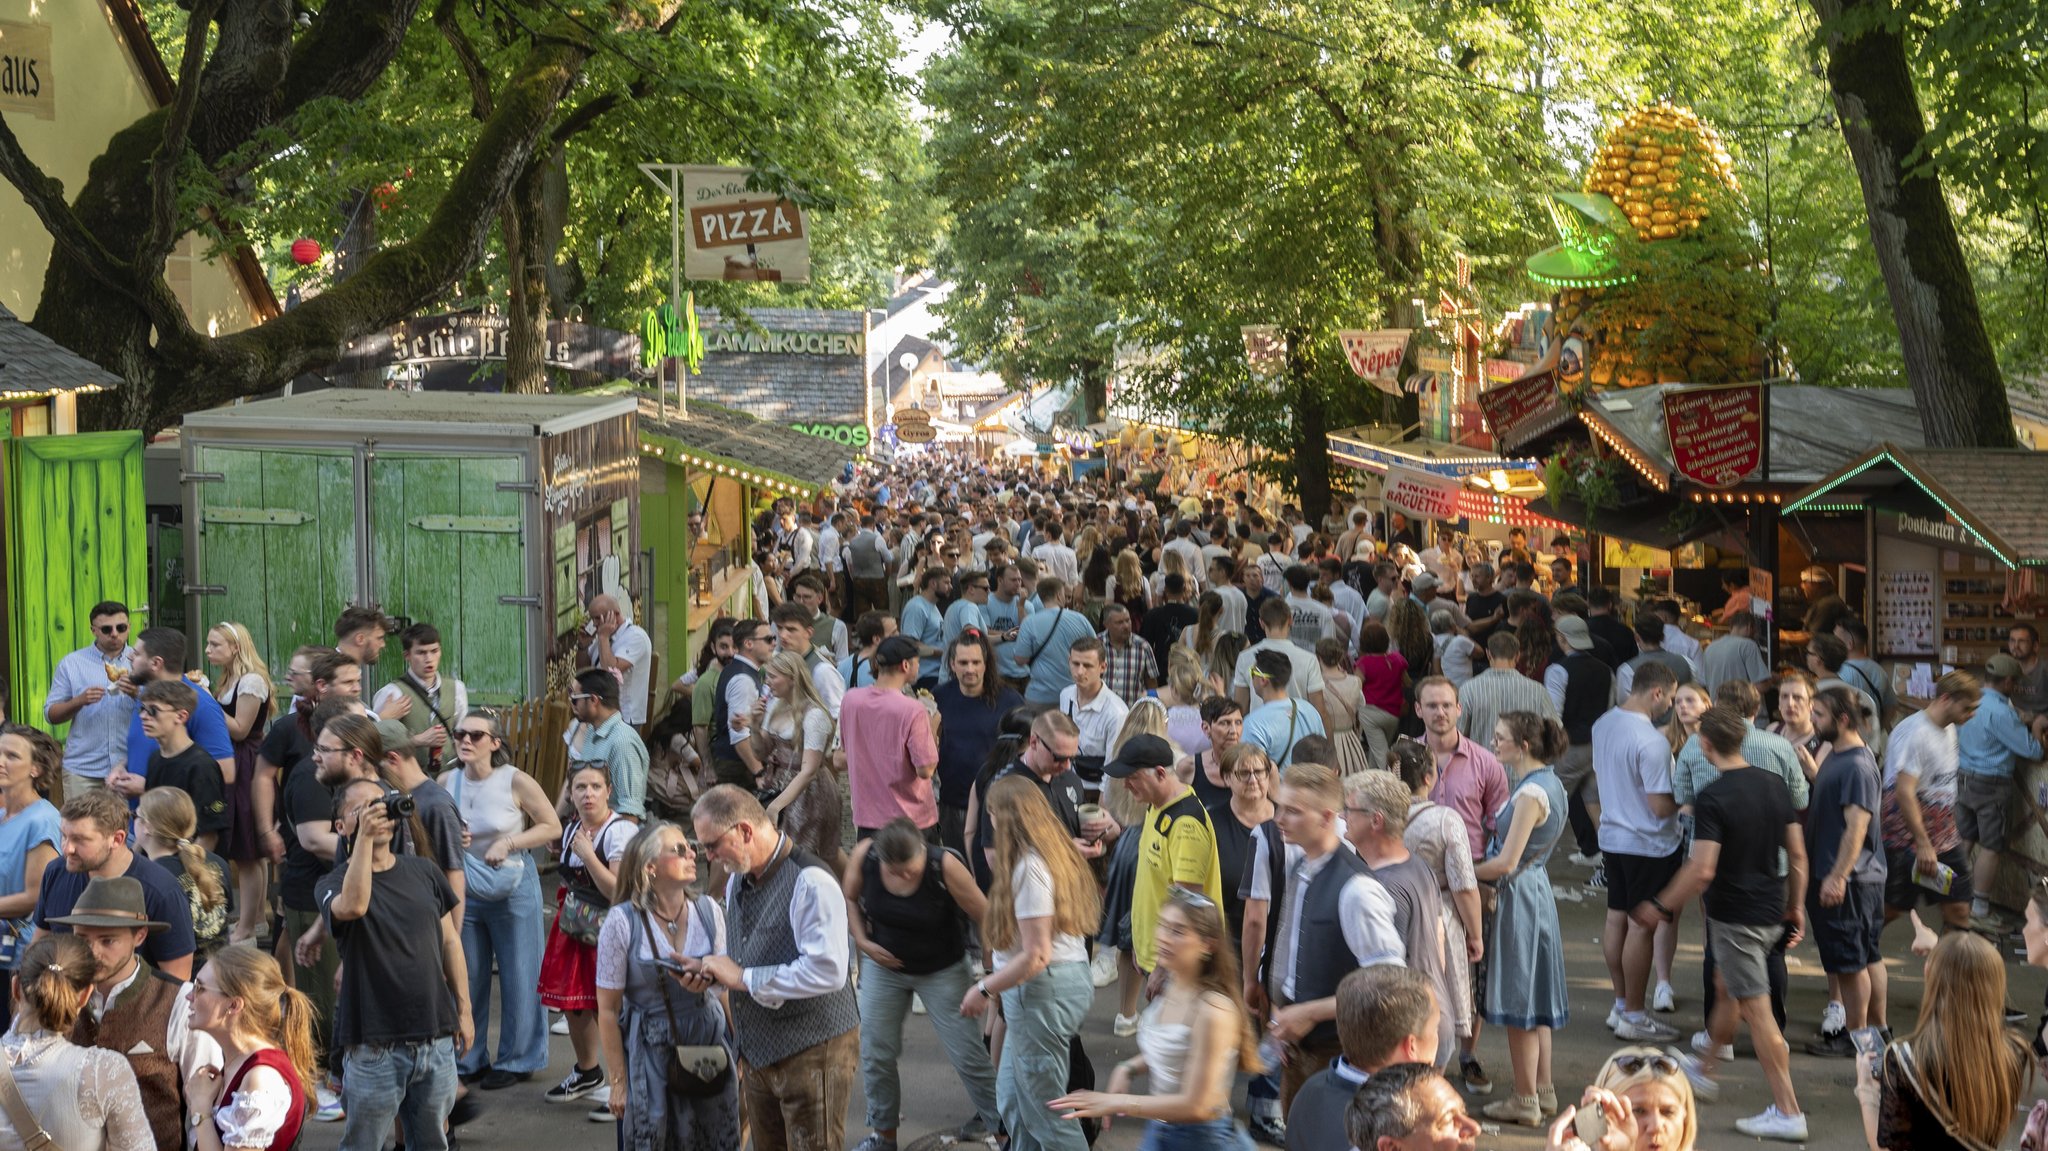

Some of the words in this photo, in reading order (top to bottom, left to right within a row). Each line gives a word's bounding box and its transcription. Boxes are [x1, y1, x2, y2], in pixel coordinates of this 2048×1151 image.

[697, 186, 721, 201] Der
[701, 206, 792, 243] PIZZA
[702, 331, 863, 355] LAMMKUCHEN
[1351, 347, 1402, 377] Crêpes
[1669, 394, 1712, 416] Bratwurst
[1708, 389, 1752, 412] Schaschlik
[1714, 404, 1747, 422] Pommes
[903, 430, 930, 438] Gyros
[1676, 419, 1699, 434] Steak
[1693, 421, 1740, 444] Hamburger
[1707, 429, 1748, 451] Feuerwurst
[1685, 439, 1756, 472] Schnitzelsandwich
[1701, 454, 1749, 478] Currywurst
[1387, 489, 1451, 515] BAGUETTES
[1398, 481, 1446, 500] KNOBI
